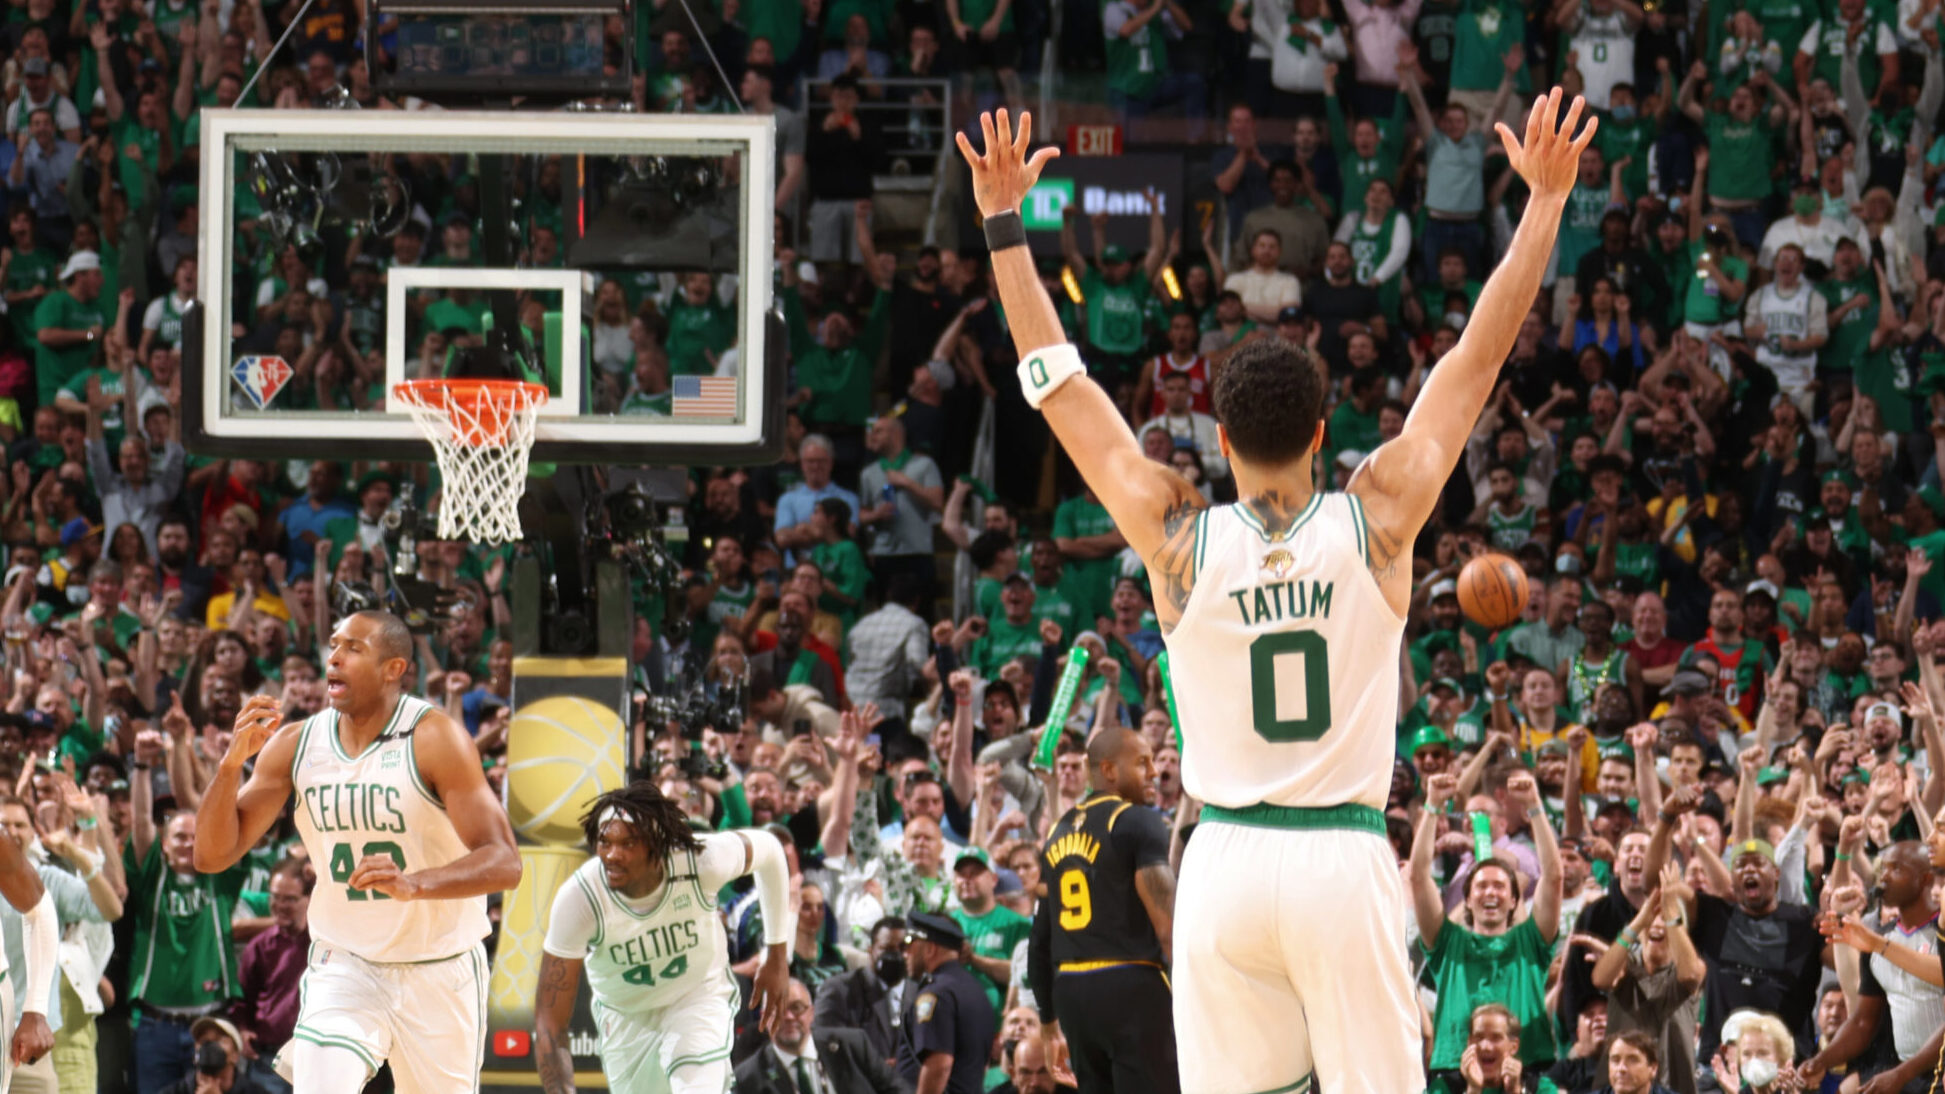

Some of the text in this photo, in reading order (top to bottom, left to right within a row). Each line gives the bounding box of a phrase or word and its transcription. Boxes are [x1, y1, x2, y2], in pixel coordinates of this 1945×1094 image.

[1077, 127, 1115, 155] EXIT
[1029, 186, 1067, 220] TD
[1029, 356, 1050, 389] 0
[1228, 580, 1334, 626] TATUM
[1250, 629, 1331, 743] 0
[304, 783, 406, 833] CELTICS
[1059, 868, 1092, 930] 9
[609, 919, 699, 966] CELTICS
[622, 953, 688, 987] 44
